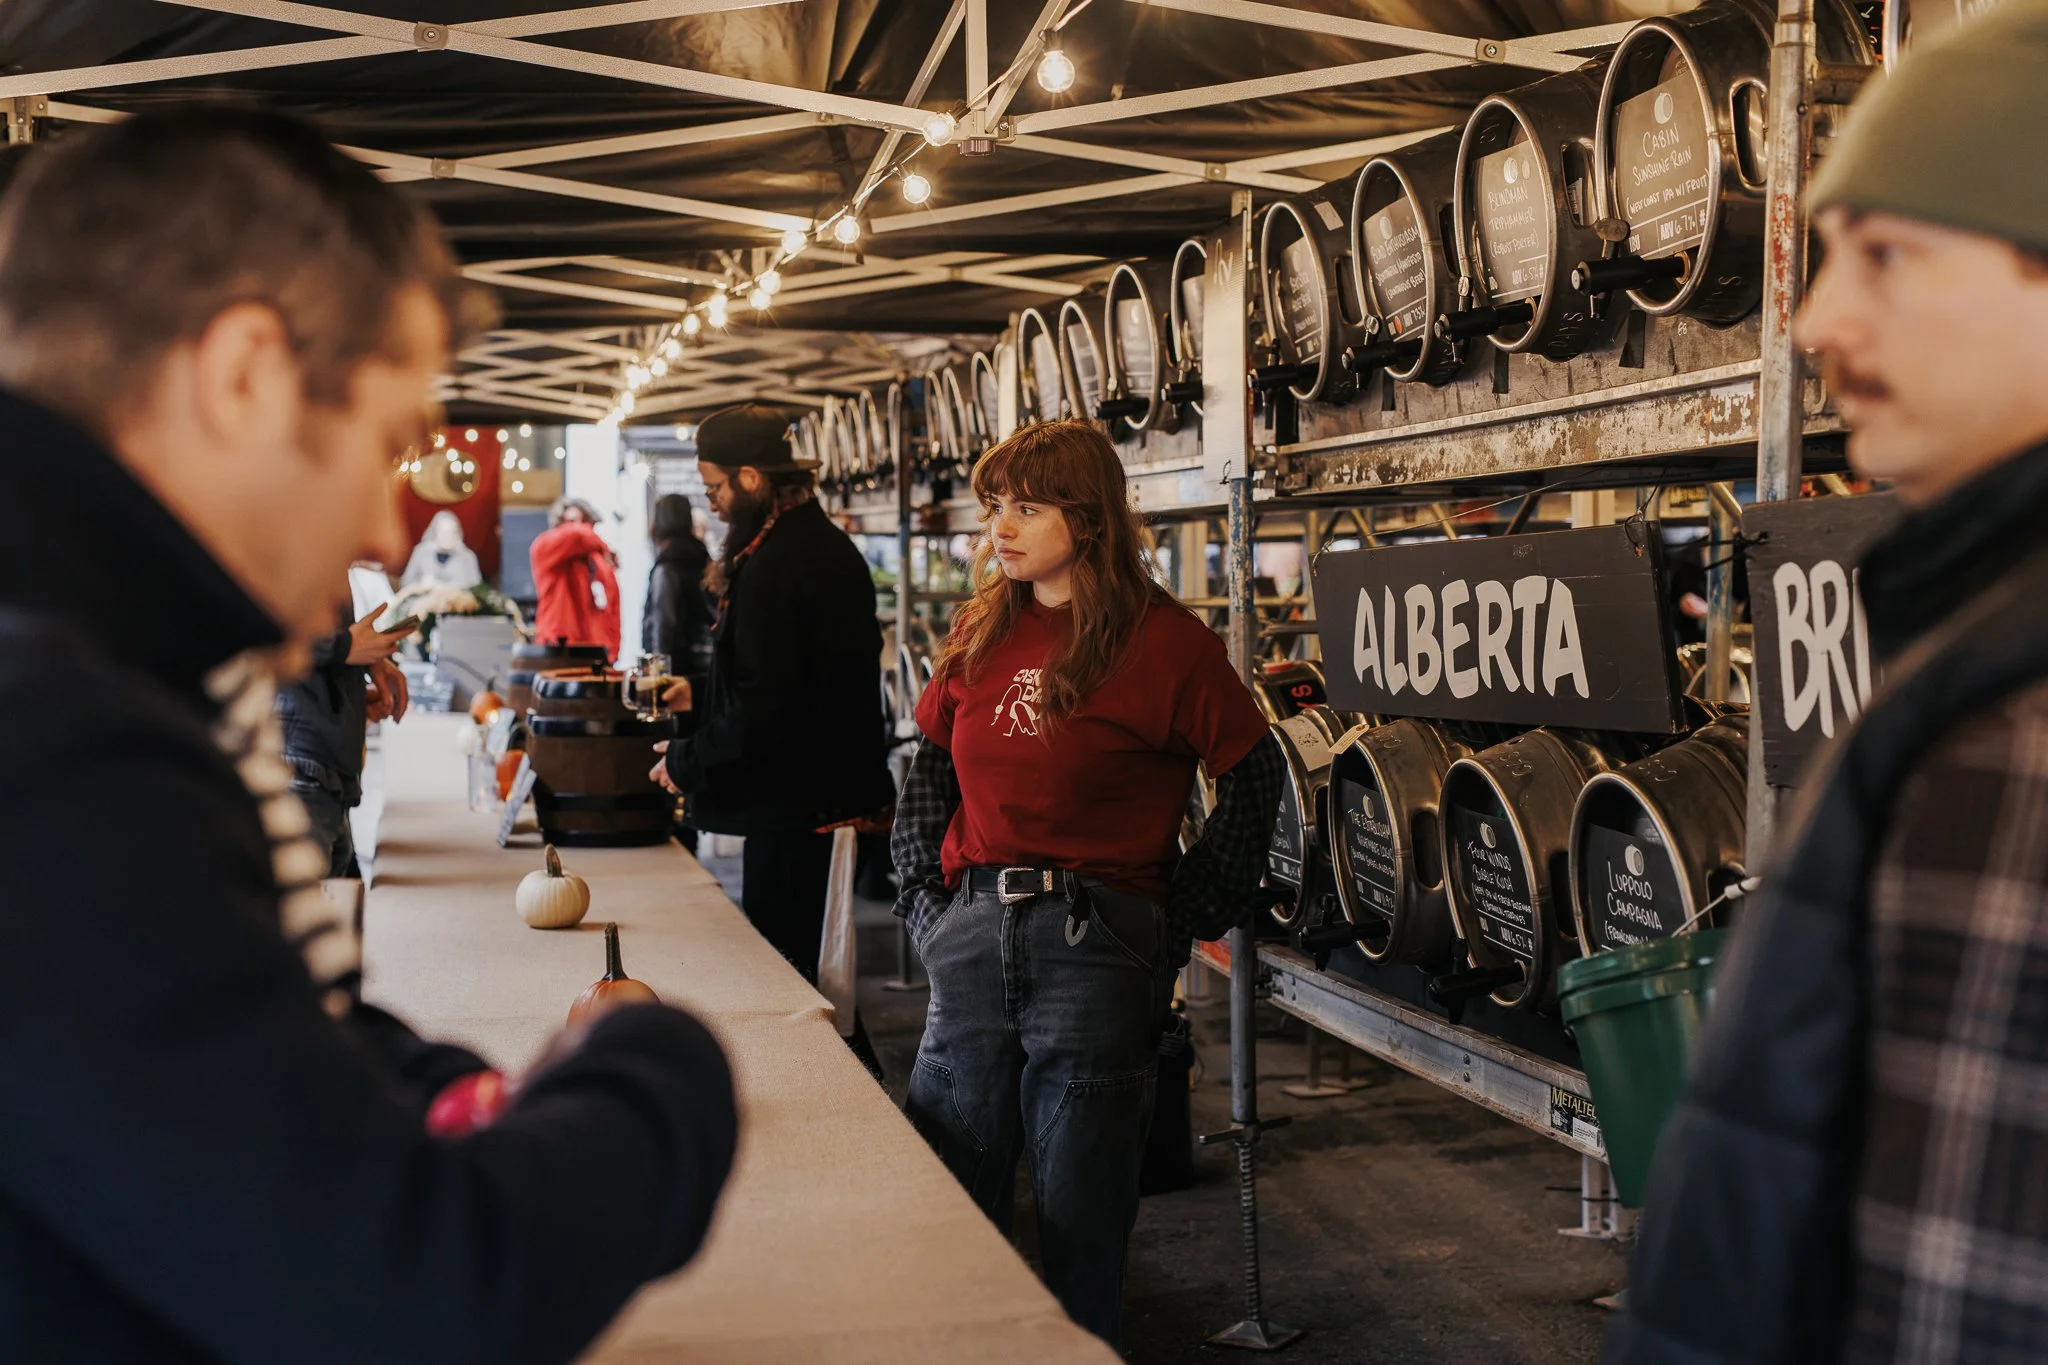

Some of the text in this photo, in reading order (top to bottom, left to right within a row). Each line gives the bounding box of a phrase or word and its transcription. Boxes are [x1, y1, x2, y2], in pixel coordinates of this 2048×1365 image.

[1642, 122, 1680, 157] CABIN
[1632, 146, 1692, 186] SUNSHINE RAIN
[1488, 182, 1529, 211] BLINDMAN
[1643, 192, 1660, 207] COAST
[1662, 188, 1675, 203] IPA
[1660, 220, 1674, 241] ABV
[1353, 575, 1590, 699] ALBERTA
[1607, 861, 1654, 901] LUPPOLO
[1607, 892, 1664, 932] CAMPAGNA
